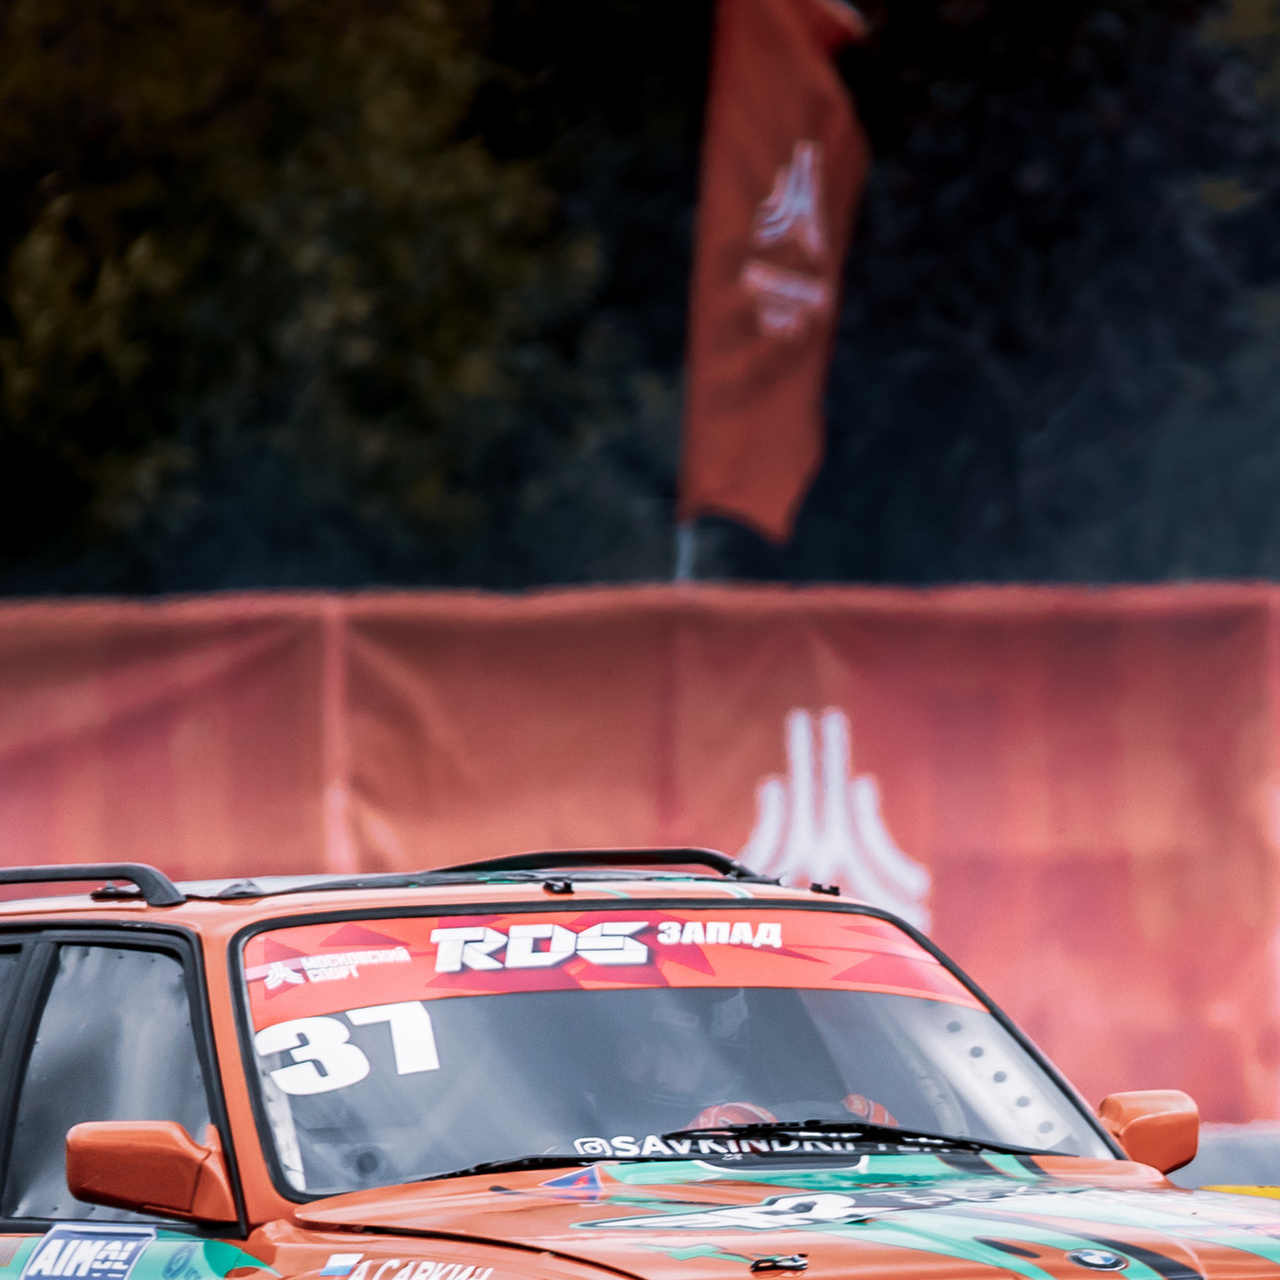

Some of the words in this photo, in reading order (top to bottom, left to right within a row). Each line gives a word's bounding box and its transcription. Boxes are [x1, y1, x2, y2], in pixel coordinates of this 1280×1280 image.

[430, 921, 649, 973] RDS
[657, 921, 783, 948] ЗАПАД
[254, 1001, 440, 1096] 37
[26, 1239, 138, 1278] AIMOL
